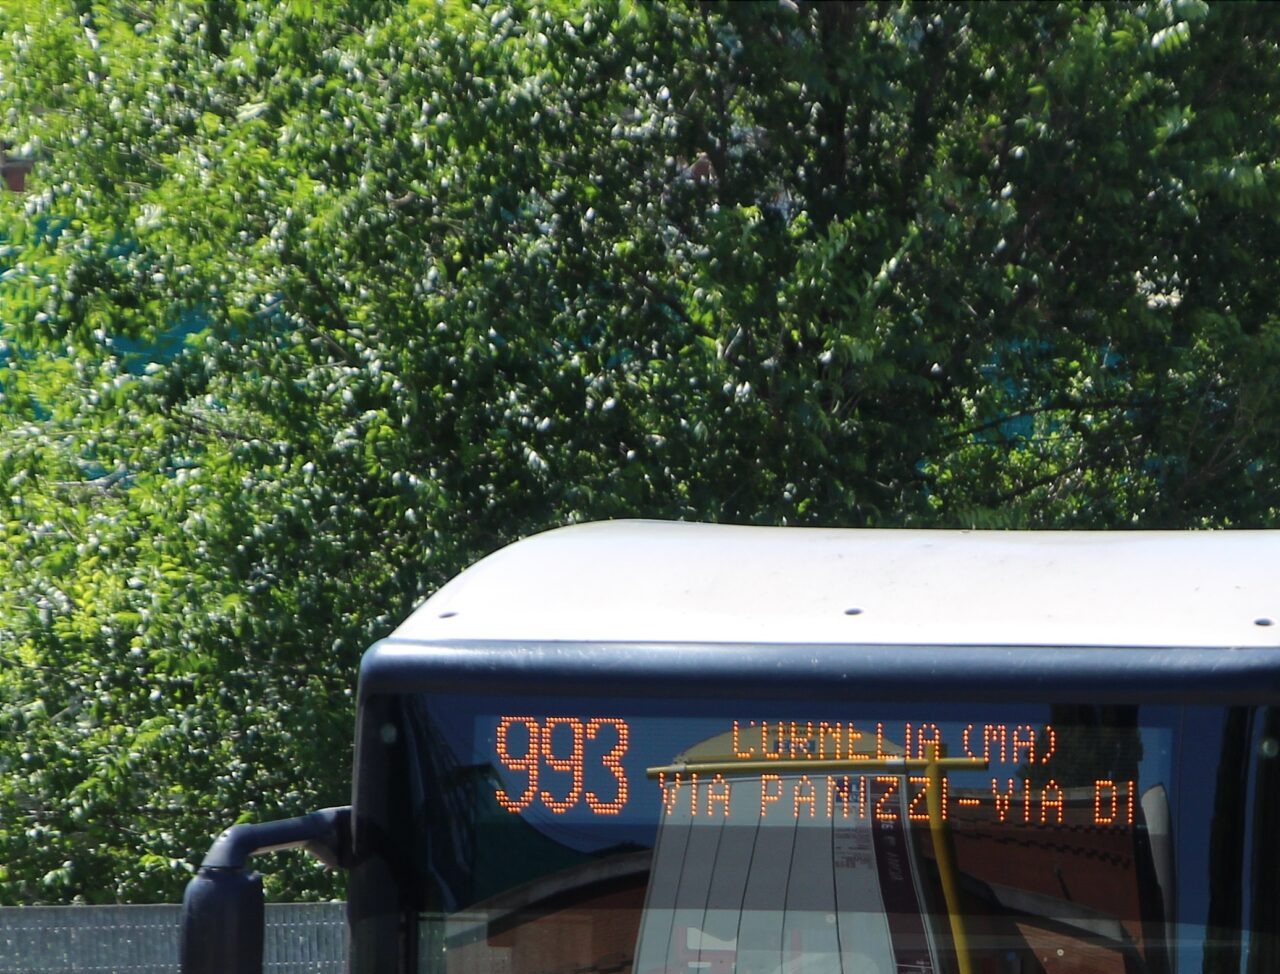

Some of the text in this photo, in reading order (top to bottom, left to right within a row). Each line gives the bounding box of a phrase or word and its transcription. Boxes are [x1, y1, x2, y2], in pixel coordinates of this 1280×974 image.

[495, 715, 630, 815] 993
[658, 771, 731, 818] VIA
[1095, 779, 1135, 824] DI
